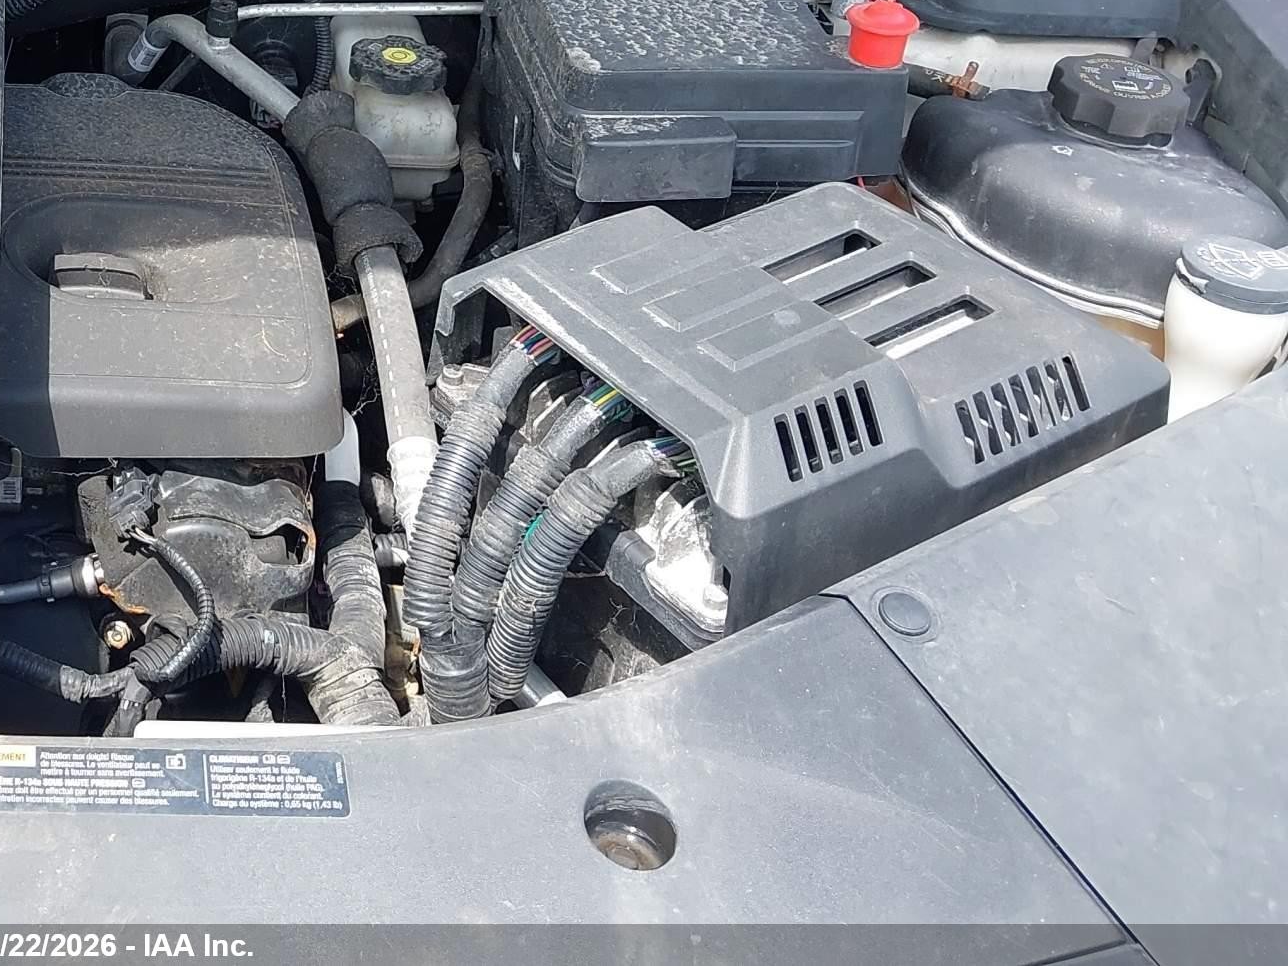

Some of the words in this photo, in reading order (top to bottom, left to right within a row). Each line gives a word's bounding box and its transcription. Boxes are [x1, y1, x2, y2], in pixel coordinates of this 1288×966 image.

[40, 751, 71, 760] Attention
[40, 760, 50, 768] de
[51, 760, 85, 768] blessures.
[87, 760, 96, 768] Le
[134, 762, 150, 771] peut
[272, 766, 279, 774] le
[41, 768, 63, 776] mettre
[71, 769, 96, 777] tourner
[115, 769, 165, 778] avertissement.
[249, 774, 275, 782] R-134a
[276, 775, 284, 783] et
[285, 775, 294, 783] de
[15, 786, 29, 794] doit
[74, 788, 87, 797] par
[25, 795, 65, 803] incorrectes
[120, 797, 133, 805] des
[213, 799, 238, 809] Charge
[239, 800, 249, 808] du
[285, 800, 301, 809] 0,65
[302, 800, 312, 810] kg
[312, 800, 331, 811] (1,43
